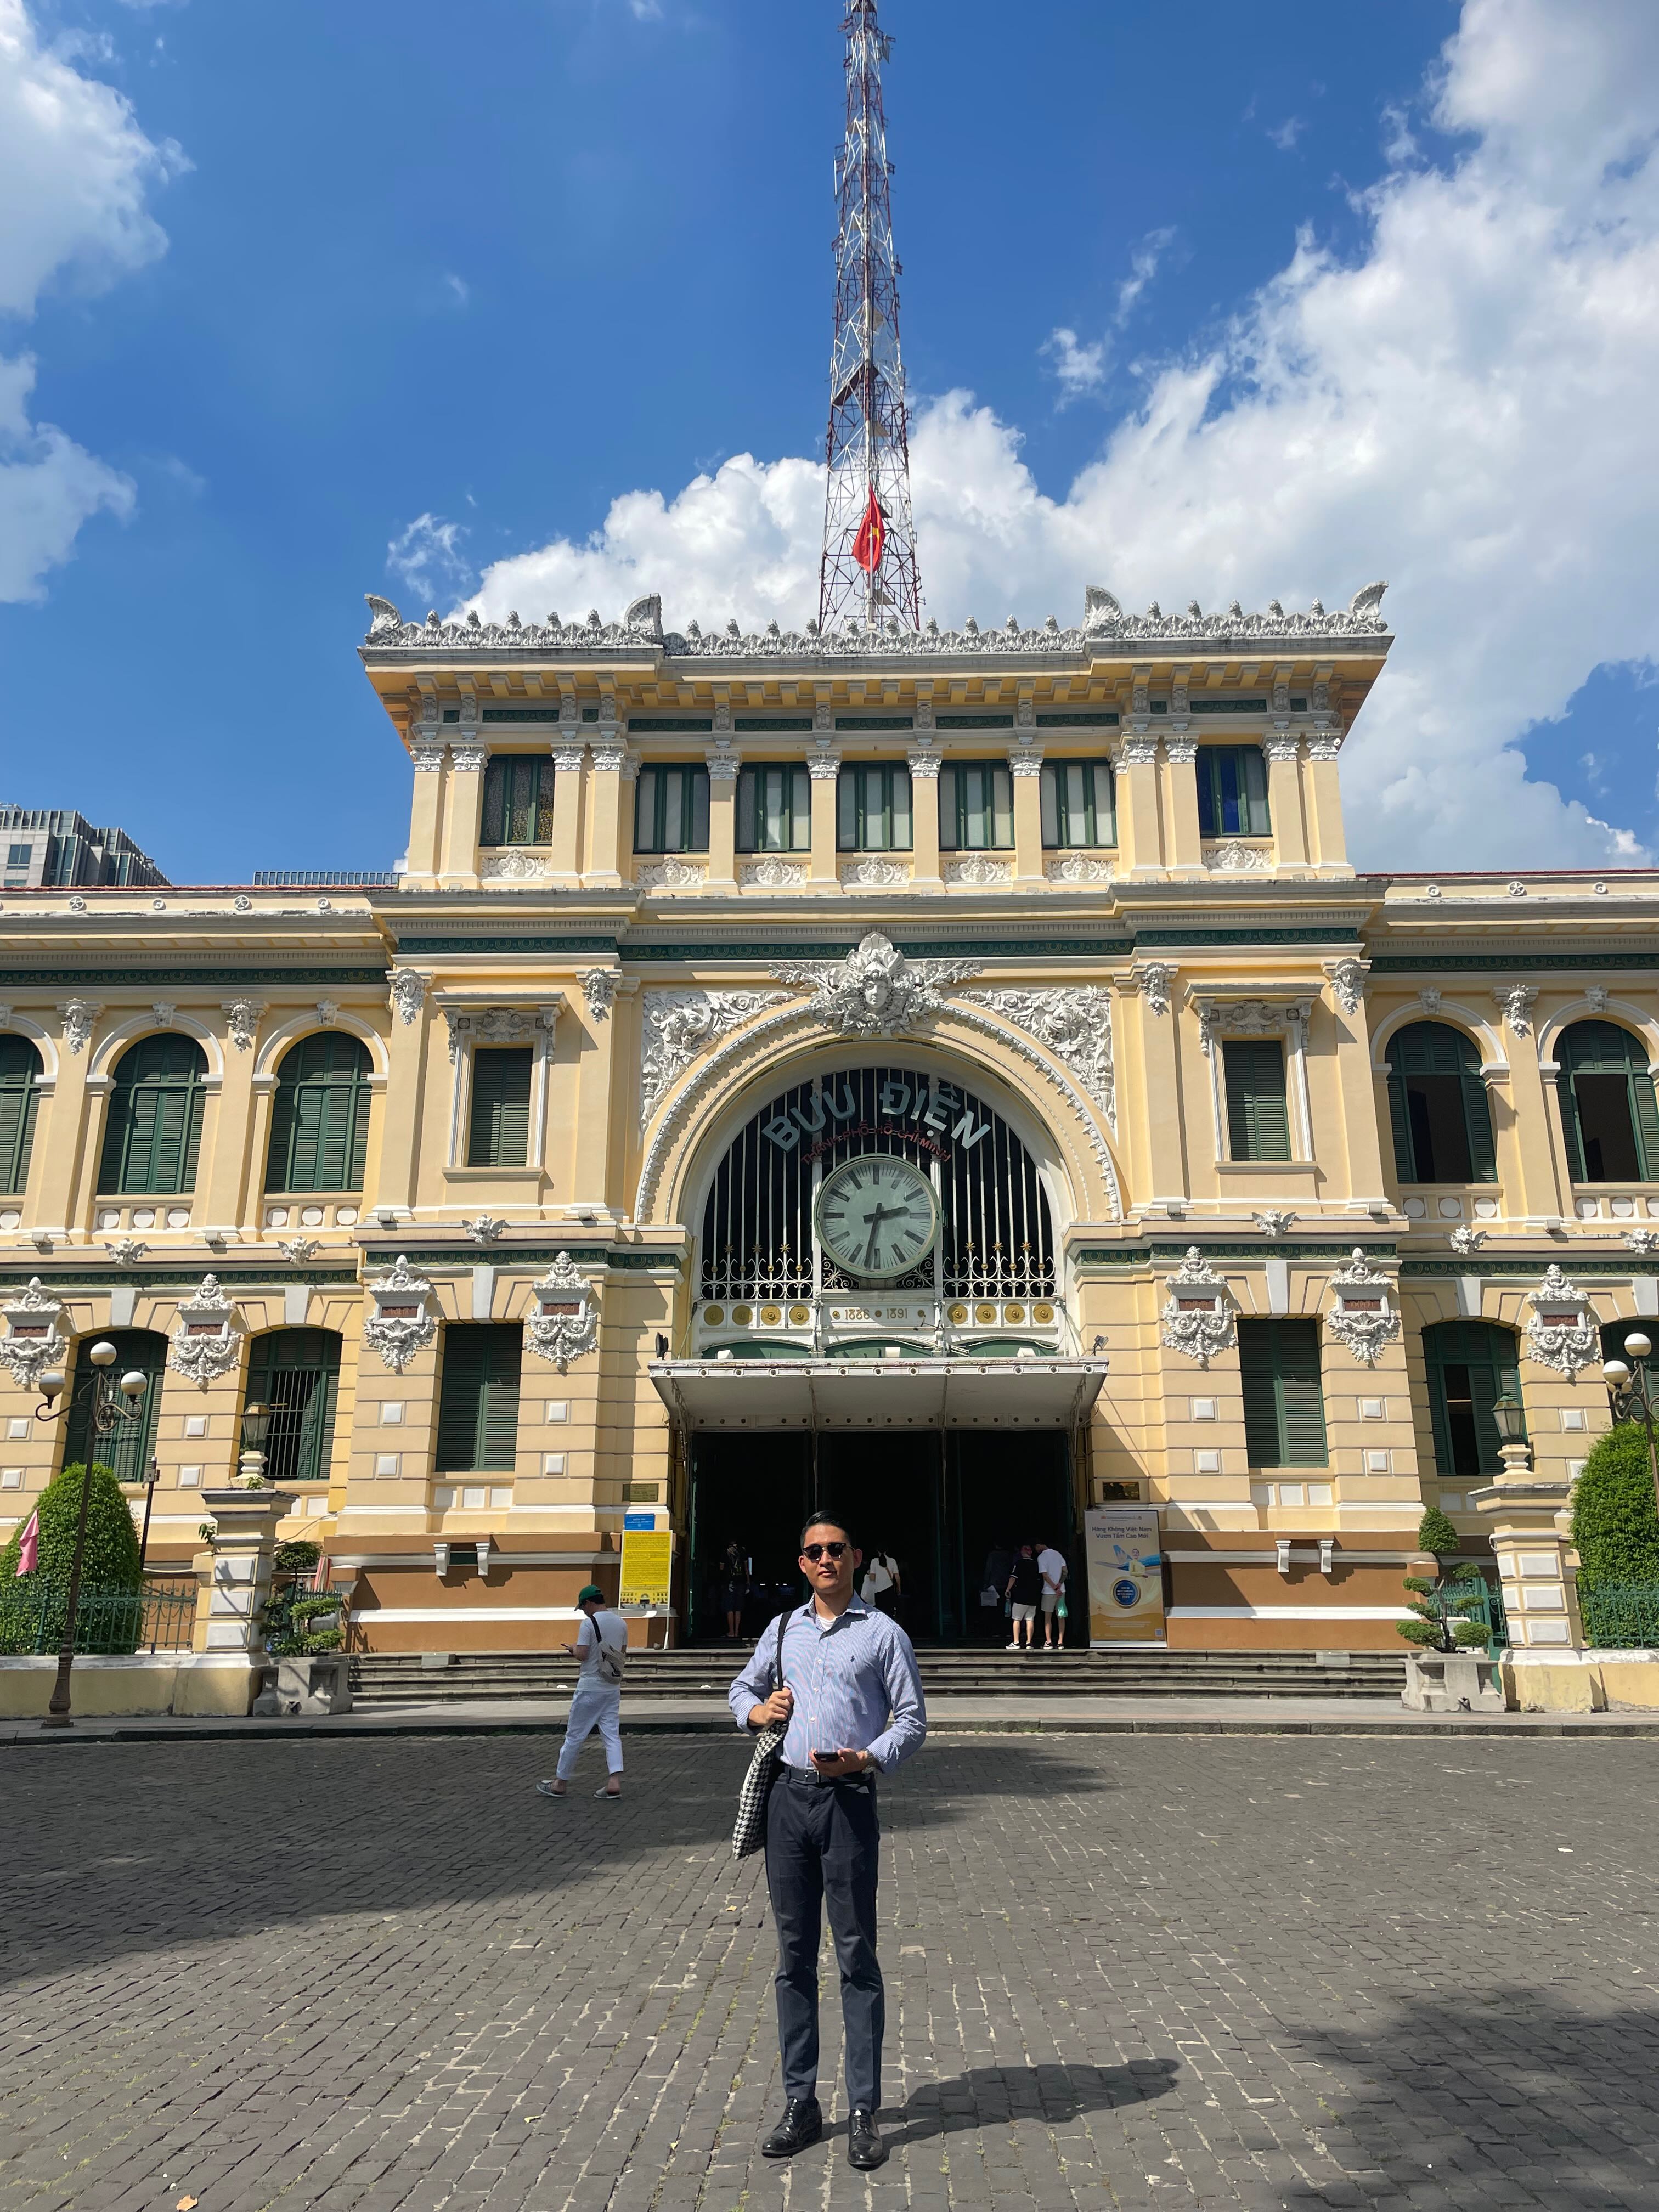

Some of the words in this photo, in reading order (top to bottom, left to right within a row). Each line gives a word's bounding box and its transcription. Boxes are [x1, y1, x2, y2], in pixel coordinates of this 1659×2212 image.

[761, 1084, 856, 1152] BƯU
[879, 1081, 991, 1150] ĐIỆN
[843, 1120, 868, 1141] PHỐ
[875, 1119, 893, 1135] HỒ
[921, 1137, 952, 1163] MINH
[845, 1308, 870, 1321] 1886
[886, 1308, 908, 1319] 1891
